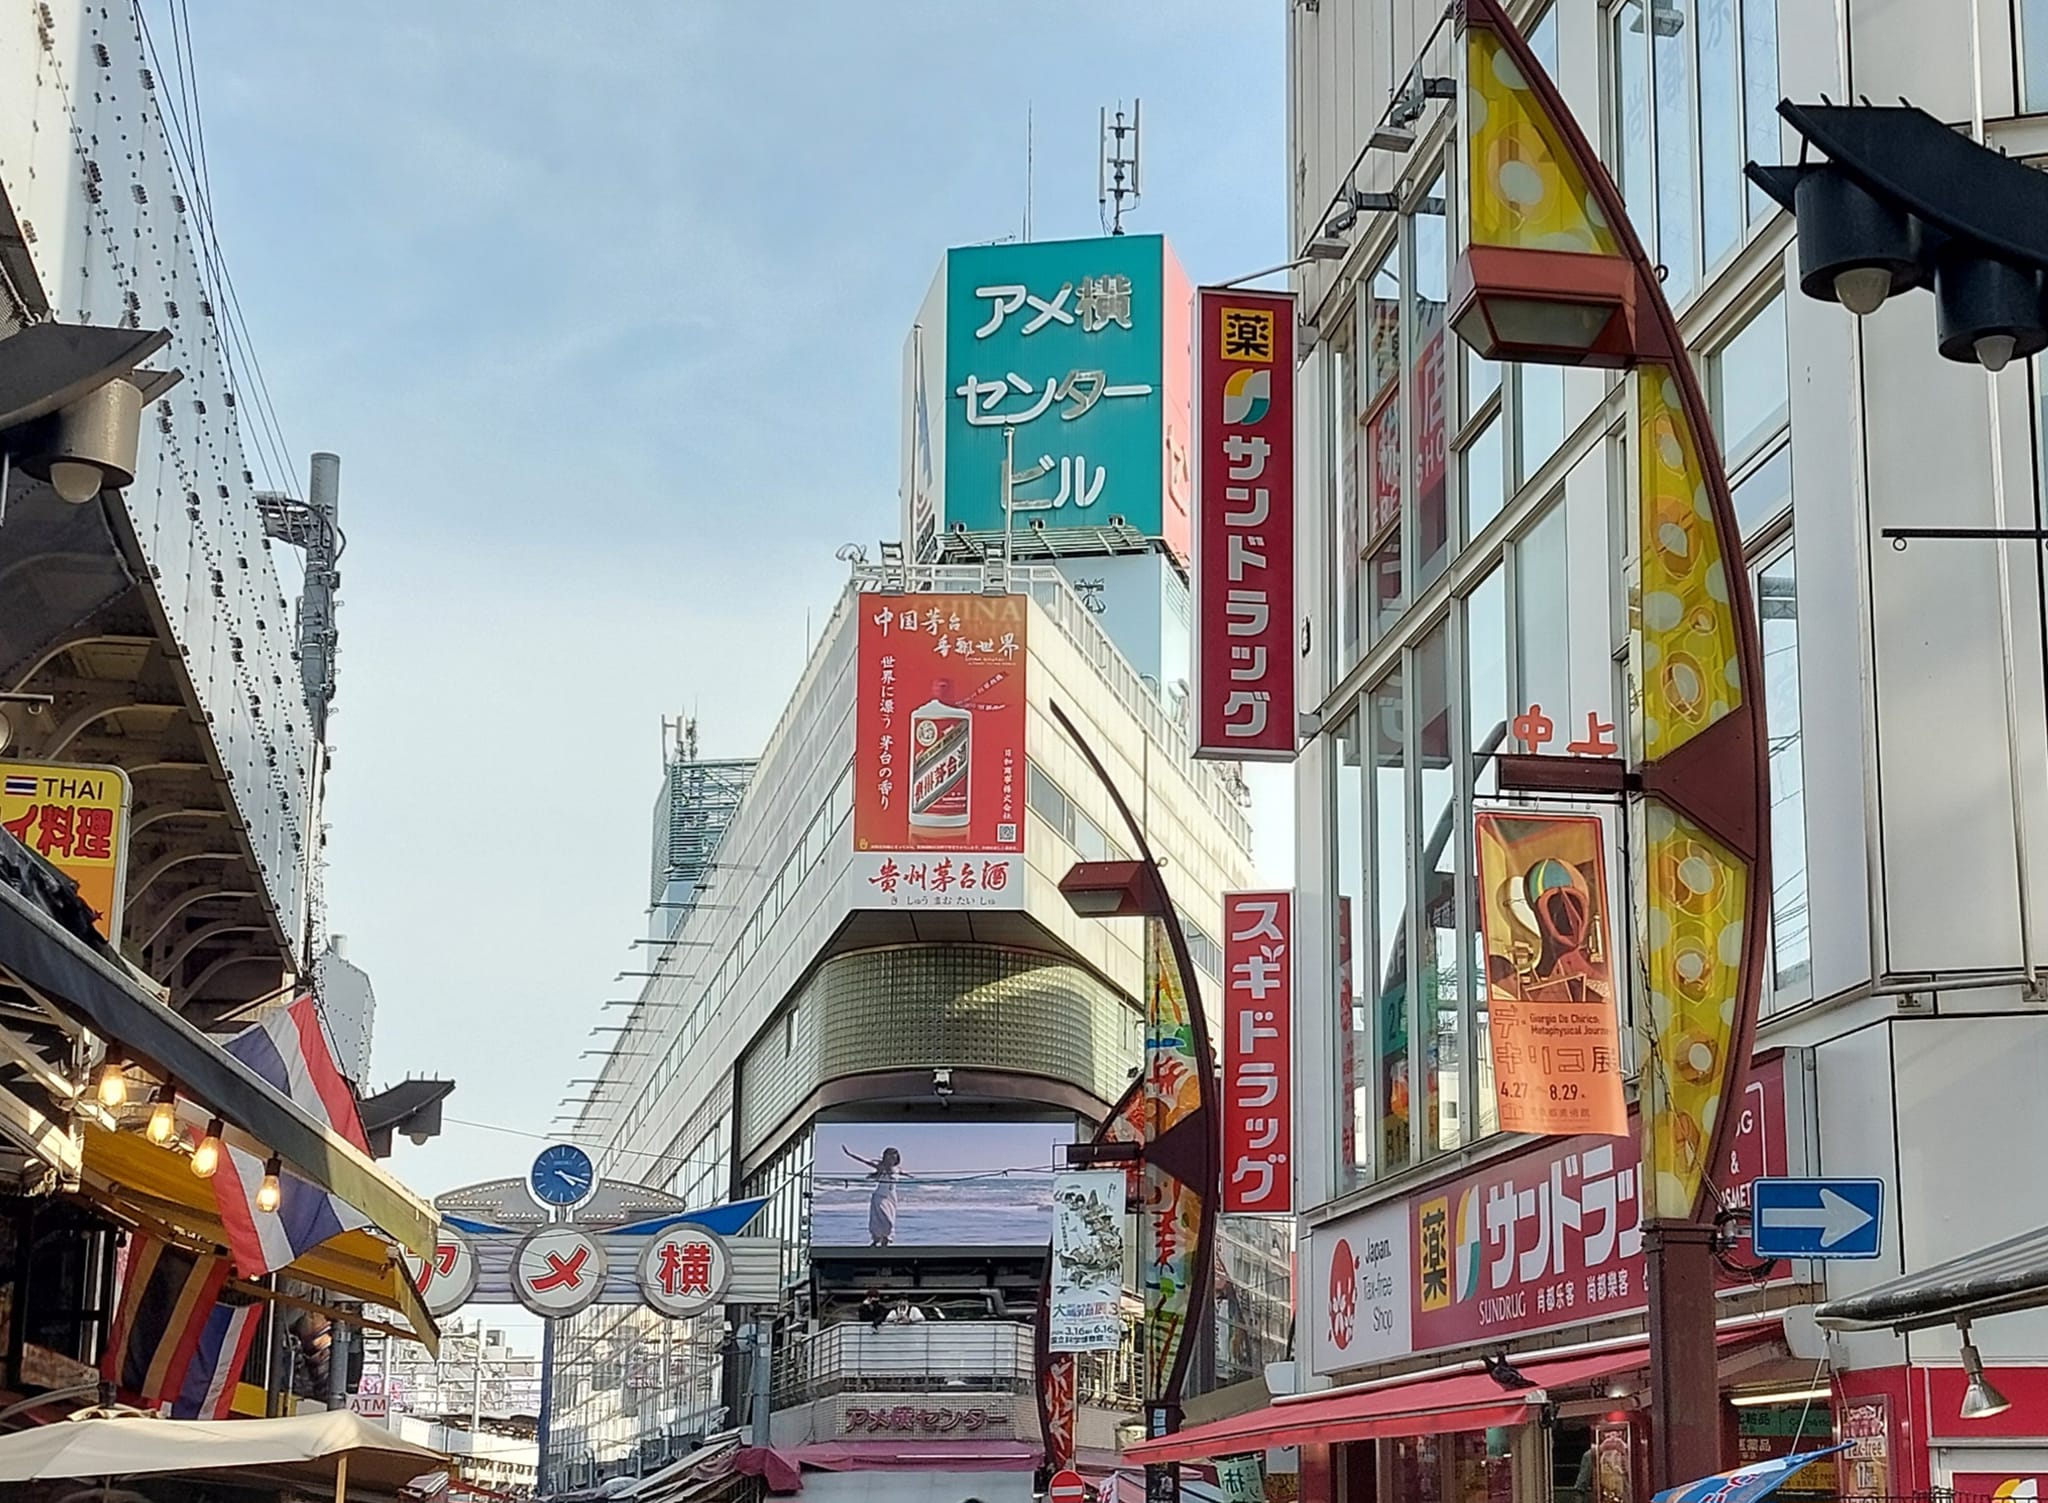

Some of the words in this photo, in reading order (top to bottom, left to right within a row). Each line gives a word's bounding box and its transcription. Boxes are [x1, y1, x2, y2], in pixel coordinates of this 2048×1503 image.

[975, 275, 1132, 339] アメ横
[1226, 314, 1270, 357] 薬
[956, 369, 1153, 426] センター
[1000, 454, 1106, 511] ビル
[1222, 434, 1271, 738] サンドラッグ
[43, 778, 103, 800] THAI
[1531, 1025, 1581, 1037] Metaphysical
[1231, 901, 1287, 1203] スギドラッグ
[1500, 1082, 1528, 1099] 4.27
[1549, 1084, 1578, 1101] 8.29
[1730, 1150, 1740, 1175] &
[1422, 1207, 1447, 1303] 薬
[1486, 1143, 1641, 1290] サンドラッ
[1479, 1291, 1526, 1326] SUNDRUG
[350, 1399, 386, 1411] ATM
[846, 1406, 1007, 1432] アメ横センター
